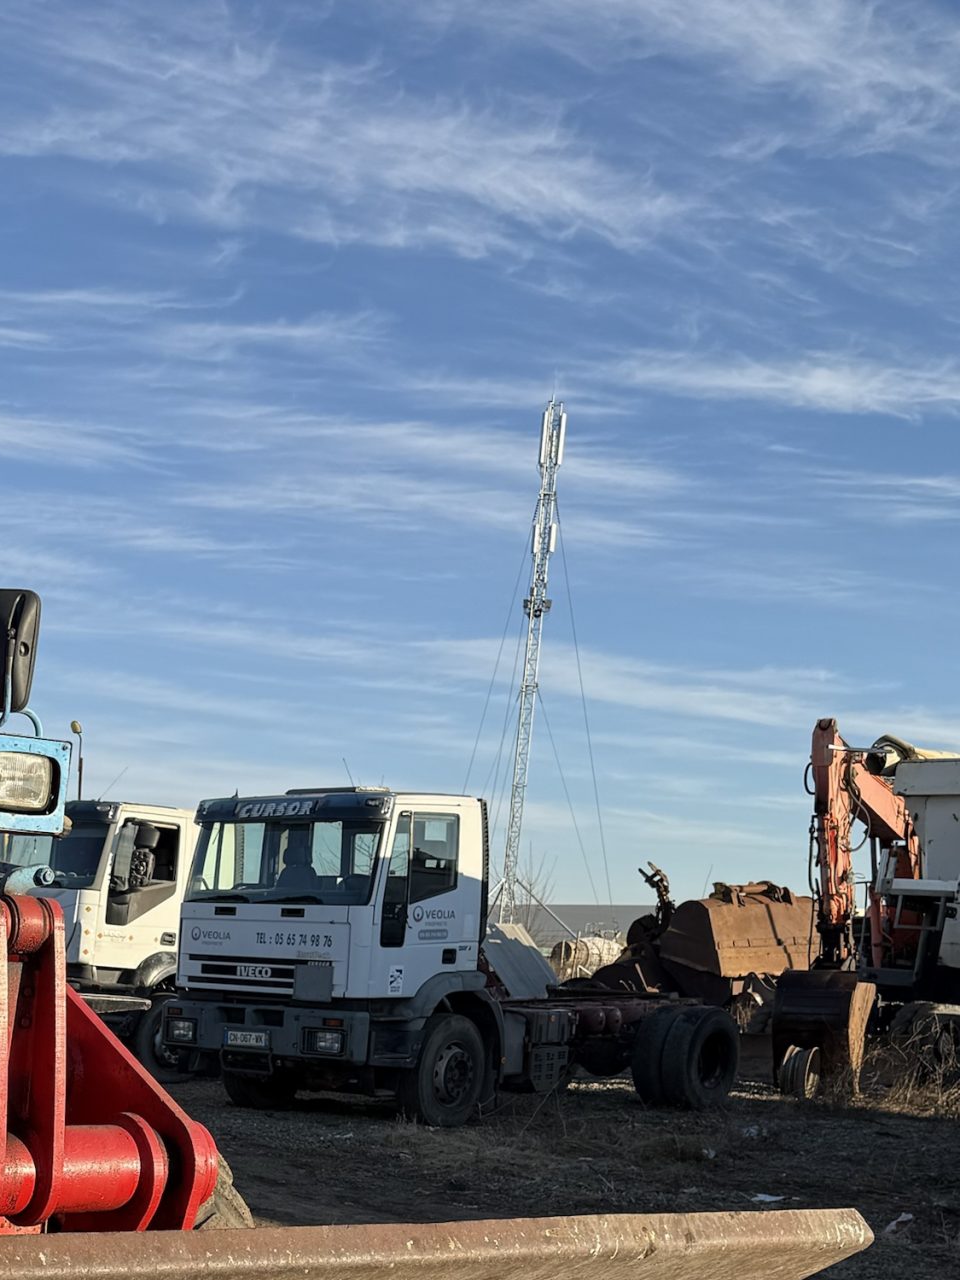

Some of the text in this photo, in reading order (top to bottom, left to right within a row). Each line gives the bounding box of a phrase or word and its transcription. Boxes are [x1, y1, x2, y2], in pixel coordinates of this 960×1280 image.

[240, 800, 313, 818] CURSOR
[425, 909, 456, 920] VEOLIA
[201, 930, 231, 940] VEOLIA
[255, 932, 267, 944] TEL
[274, 932, 284, 945] 05
[286, 933, 296, 946] 65
[298, 934, 307, 946] 74
[310, 934, 320, 947] 98
[323, 935, 333, 948] 76
[236, 965, 272, 978] IVECO
